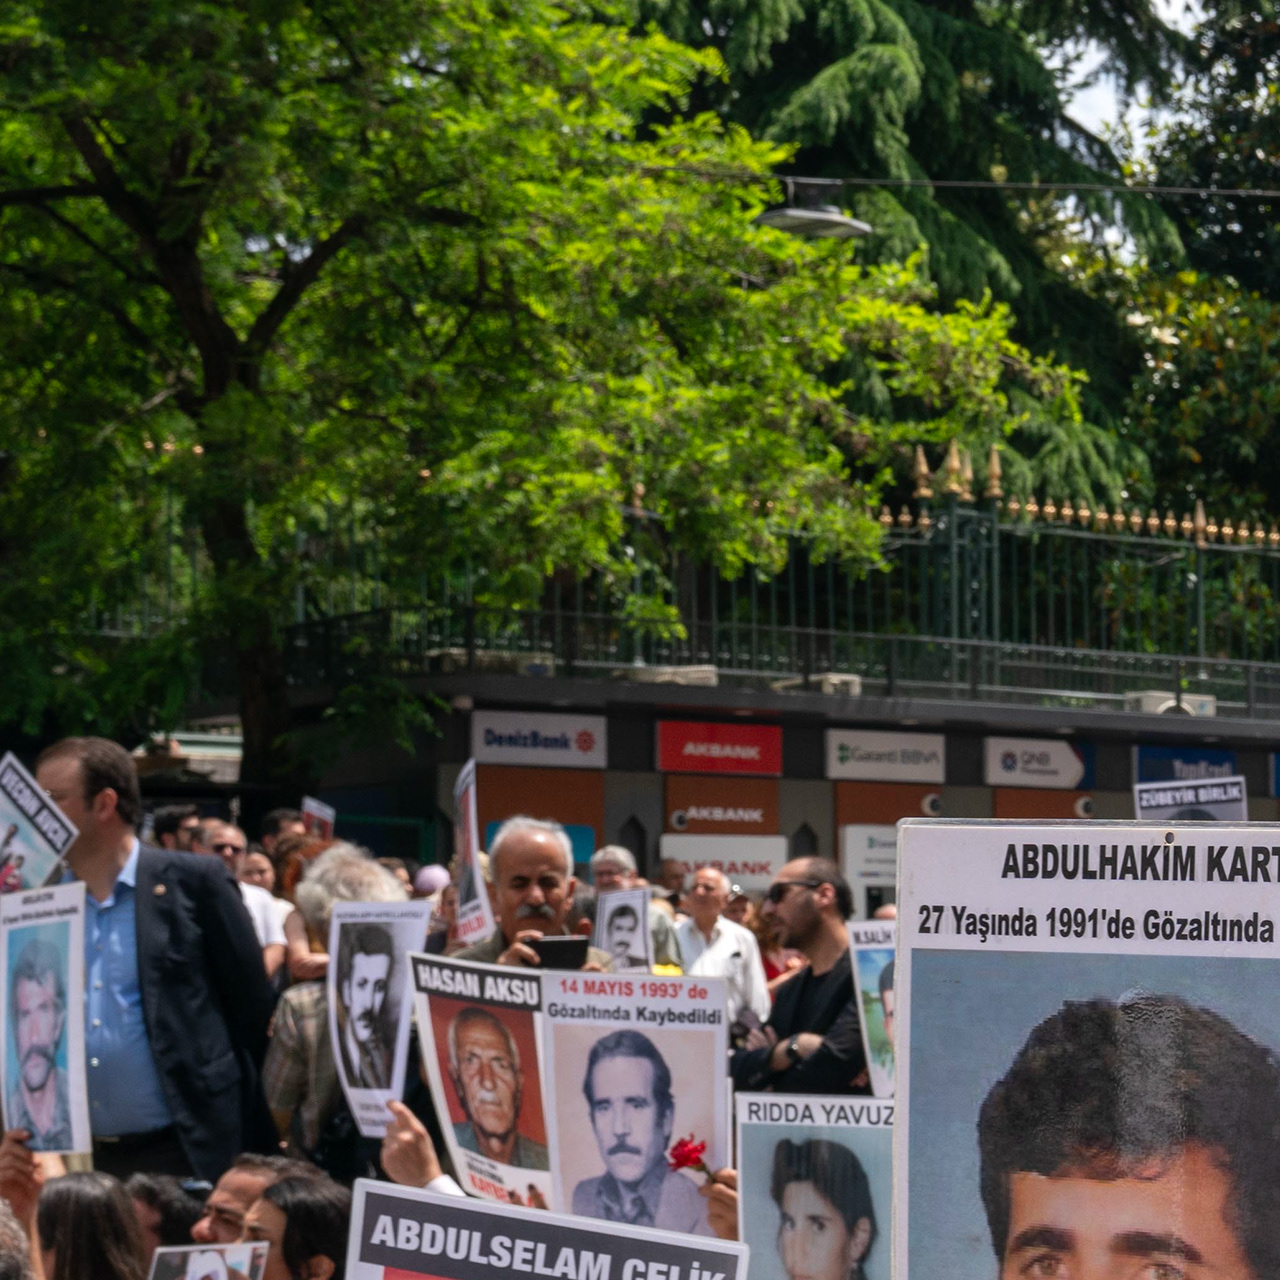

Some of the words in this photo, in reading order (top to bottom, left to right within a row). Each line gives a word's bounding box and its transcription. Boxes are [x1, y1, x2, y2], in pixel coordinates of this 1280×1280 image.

[484, 727, 571, 750] DenizBank
[683, 741, 761, 761] AKBANK
[1197, 782, 1242, 803] BİRLİK
[686, 806, 763, 823] AKBANK
[1001, 842, 1196, 883] ABDULHAKİM
[918, 905, 944, 934] 27
[951, 906, 1038, 944] Yaşında
[1046, 907, 1135, 940] 1991'de
[1143, 909, 1274, 944] Gözaltında
[417, 964, 481, 998] HASAN
[484, 973, 540, 1006] AKSU
[560, 978, 592, 995] 14
[597, 979, 634, 997] MAYIS
[687, 983, 709, 999] de
[547, 1002, 632, 1021] Gözaltında
[635, 1005, 723, 1026] Kaybedildi
[748, 1102, 815, 1124] RIDDA
[821, 1104, 894, 1127] YAVUZ
